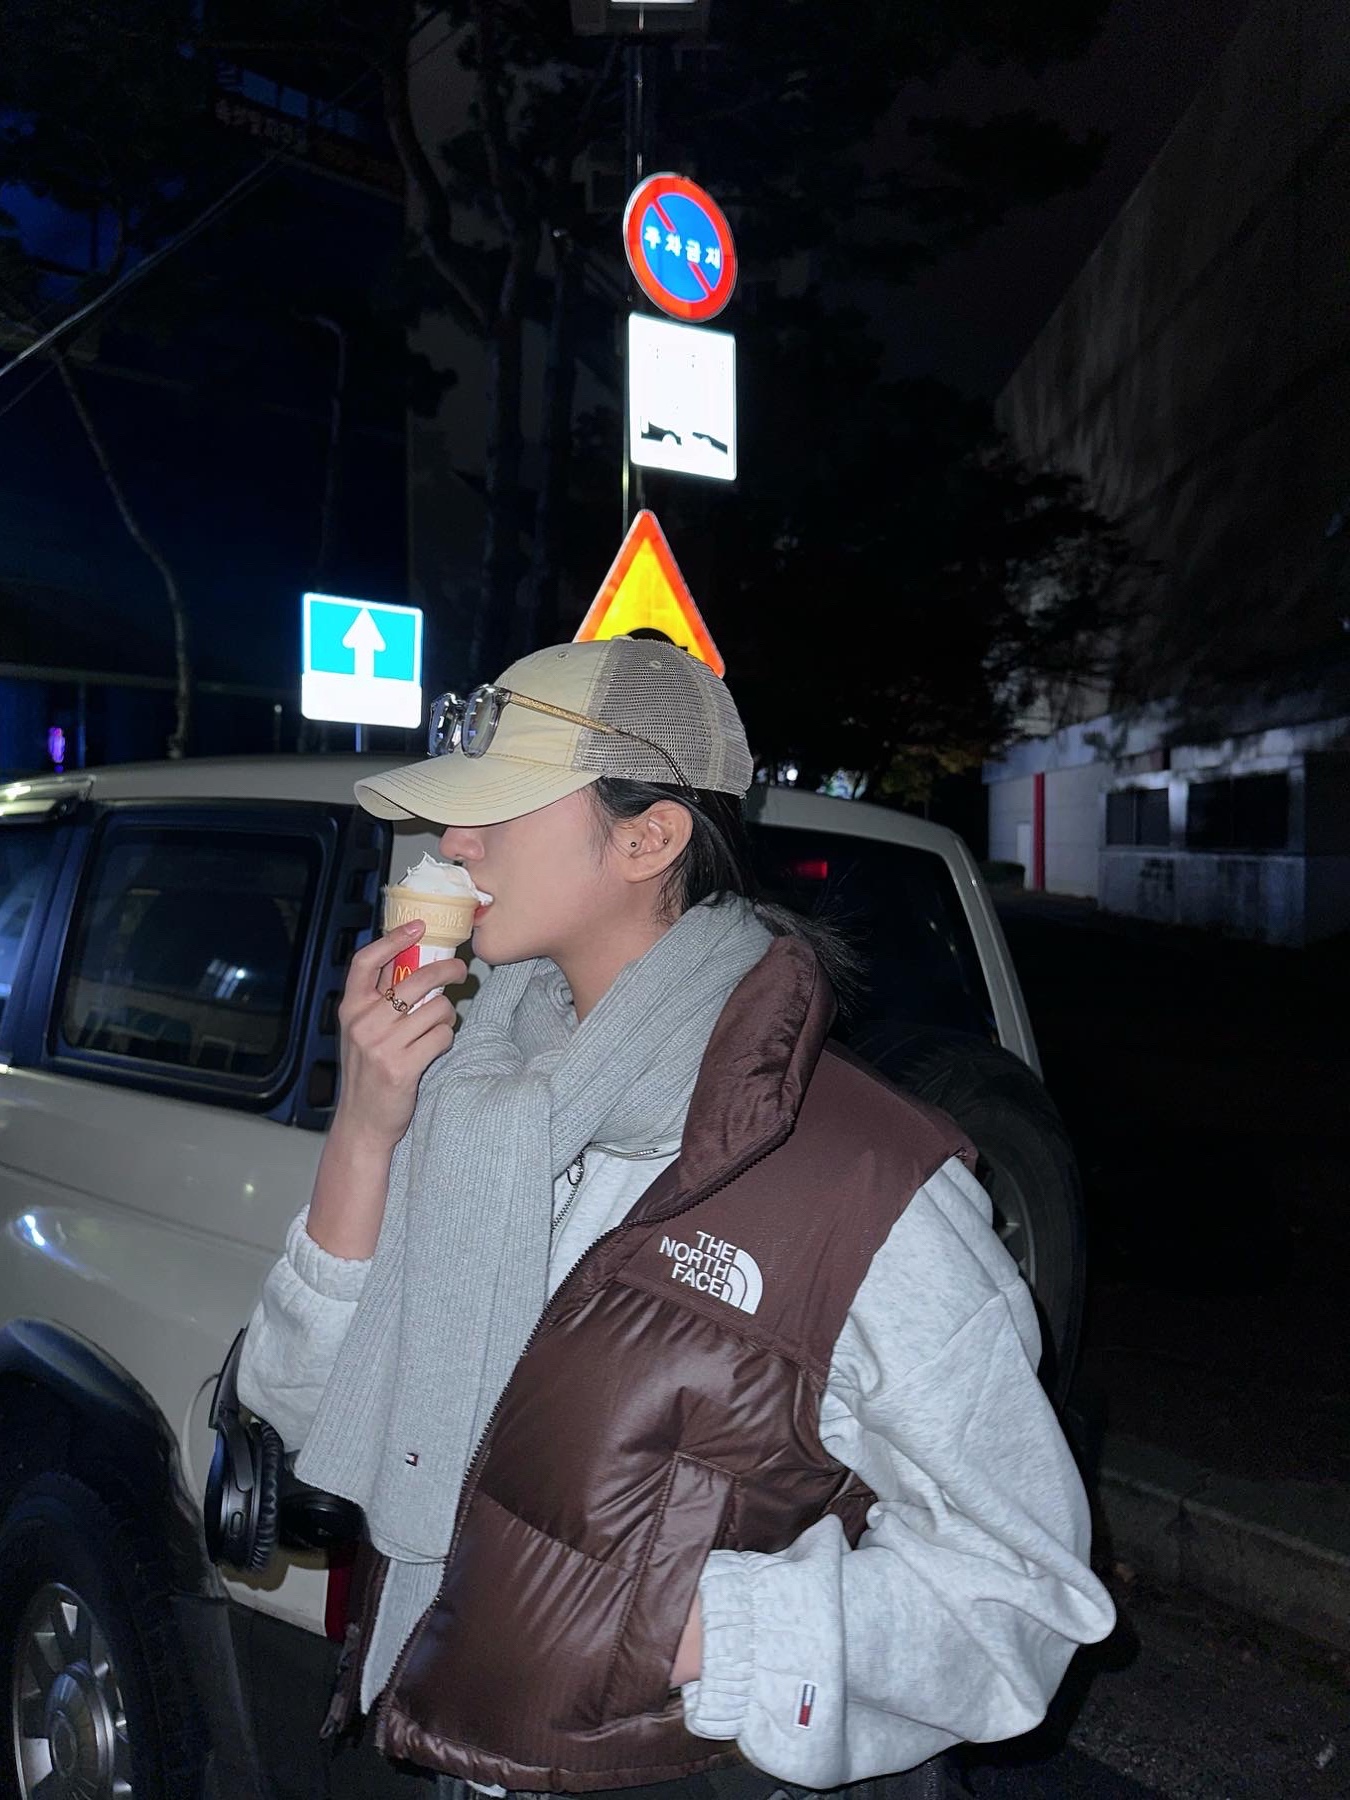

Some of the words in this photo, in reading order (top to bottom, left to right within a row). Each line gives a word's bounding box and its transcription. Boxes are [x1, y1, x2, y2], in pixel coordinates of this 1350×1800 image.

[659, 1235, 730, 1281] NORTH
[696, 1230, 737, 1263] THE
[671, 1262, 725, 1298] FACE
